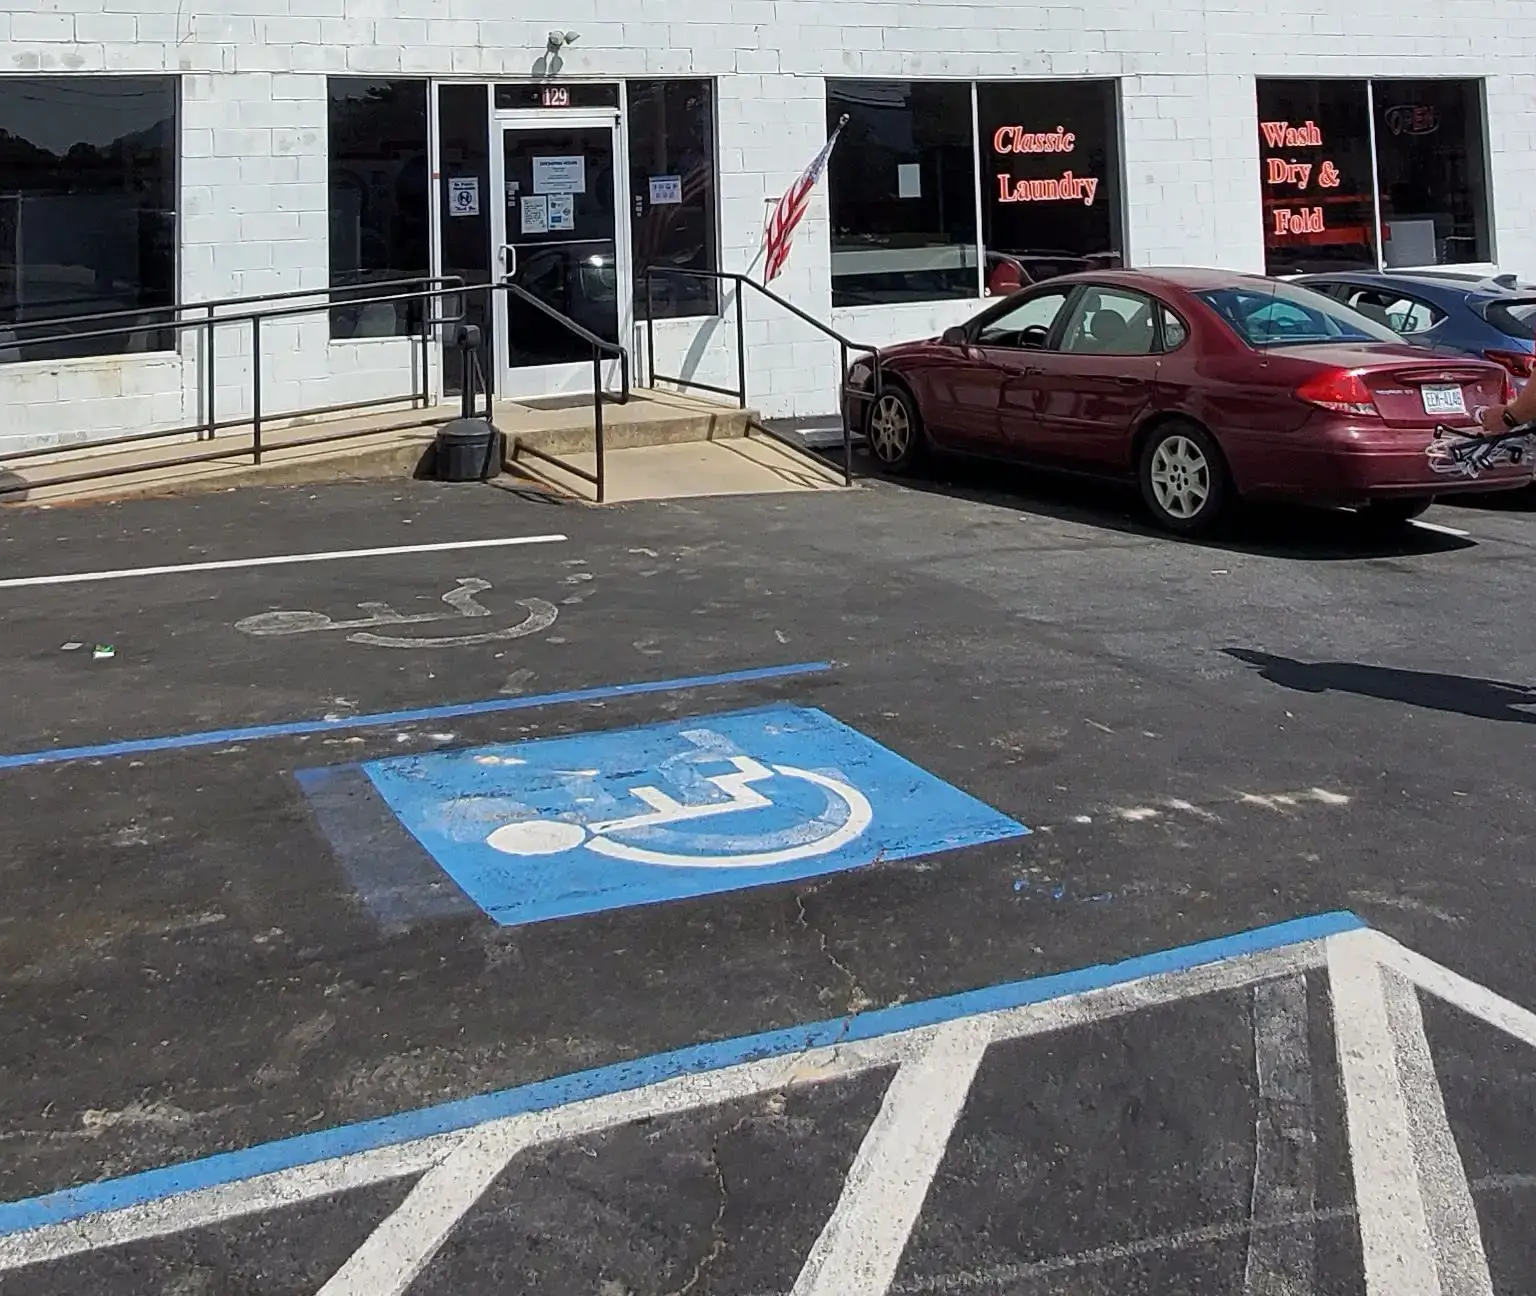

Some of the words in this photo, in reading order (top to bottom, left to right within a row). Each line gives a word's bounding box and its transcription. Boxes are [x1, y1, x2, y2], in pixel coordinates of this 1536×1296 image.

[544, 87, 568, 106] 129
[993, 125, 1076, 154] Classic
[1260, 120, 1323, 148] Wash
[996, 170, 1098, 206] Laundry
[1267, 158, 1312, 189] Dry
[1318, 160, 1341, 188] &
[1273, 206, 1325, 235] Fold
